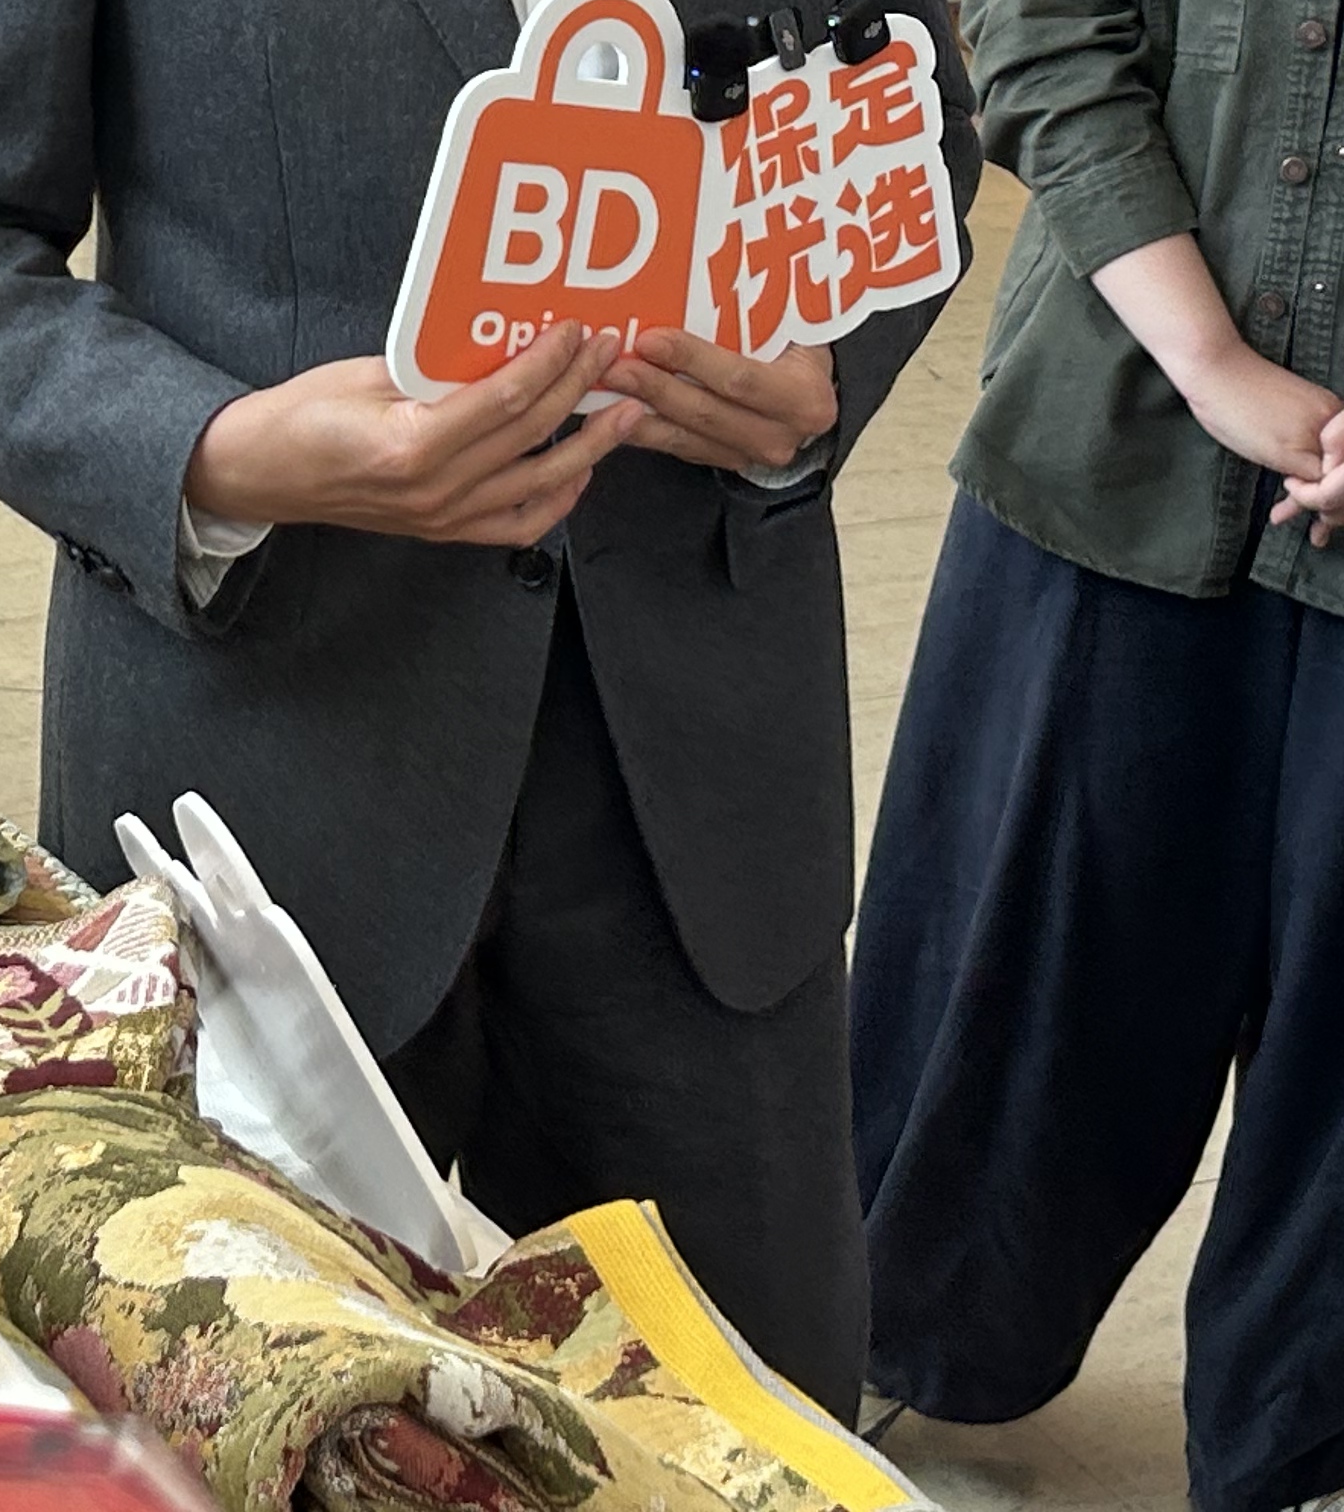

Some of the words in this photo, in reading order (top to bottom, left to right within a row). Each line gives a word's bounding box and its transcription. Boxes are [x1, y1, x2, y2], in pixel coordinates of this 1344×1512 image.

[719, 40, 925, 208] 保定
[482, 162, 659, 289] BD
[707, 165, 942, 352] 优选
